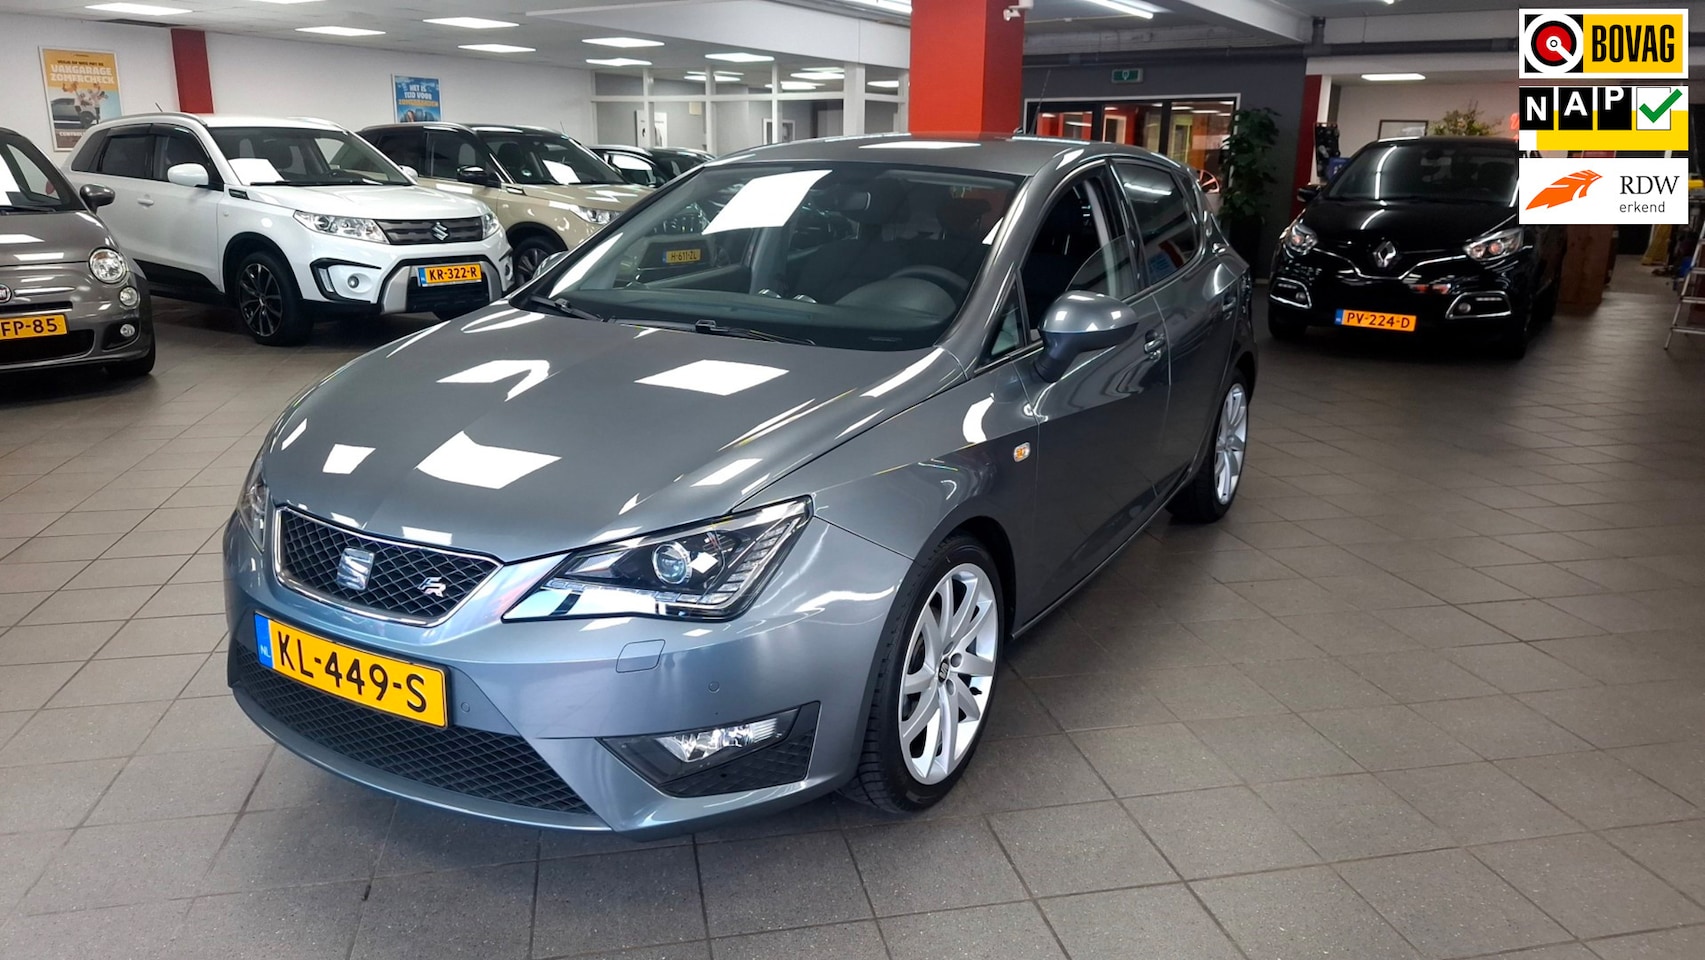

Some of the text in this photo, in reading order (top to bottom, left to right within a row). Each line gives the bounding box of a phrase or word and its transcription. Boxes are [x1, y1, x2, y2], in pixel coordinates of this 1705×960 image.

[50, 64, 112, 76] VAKGARAGE
[50, 73, 115, 84] ZOMERCHECK
[429, 266, 478, 281] KR-322-R
[1346, 312, 1411, 329] PV-224-D
[260, 630, 428, 714] NL KL-449-S
